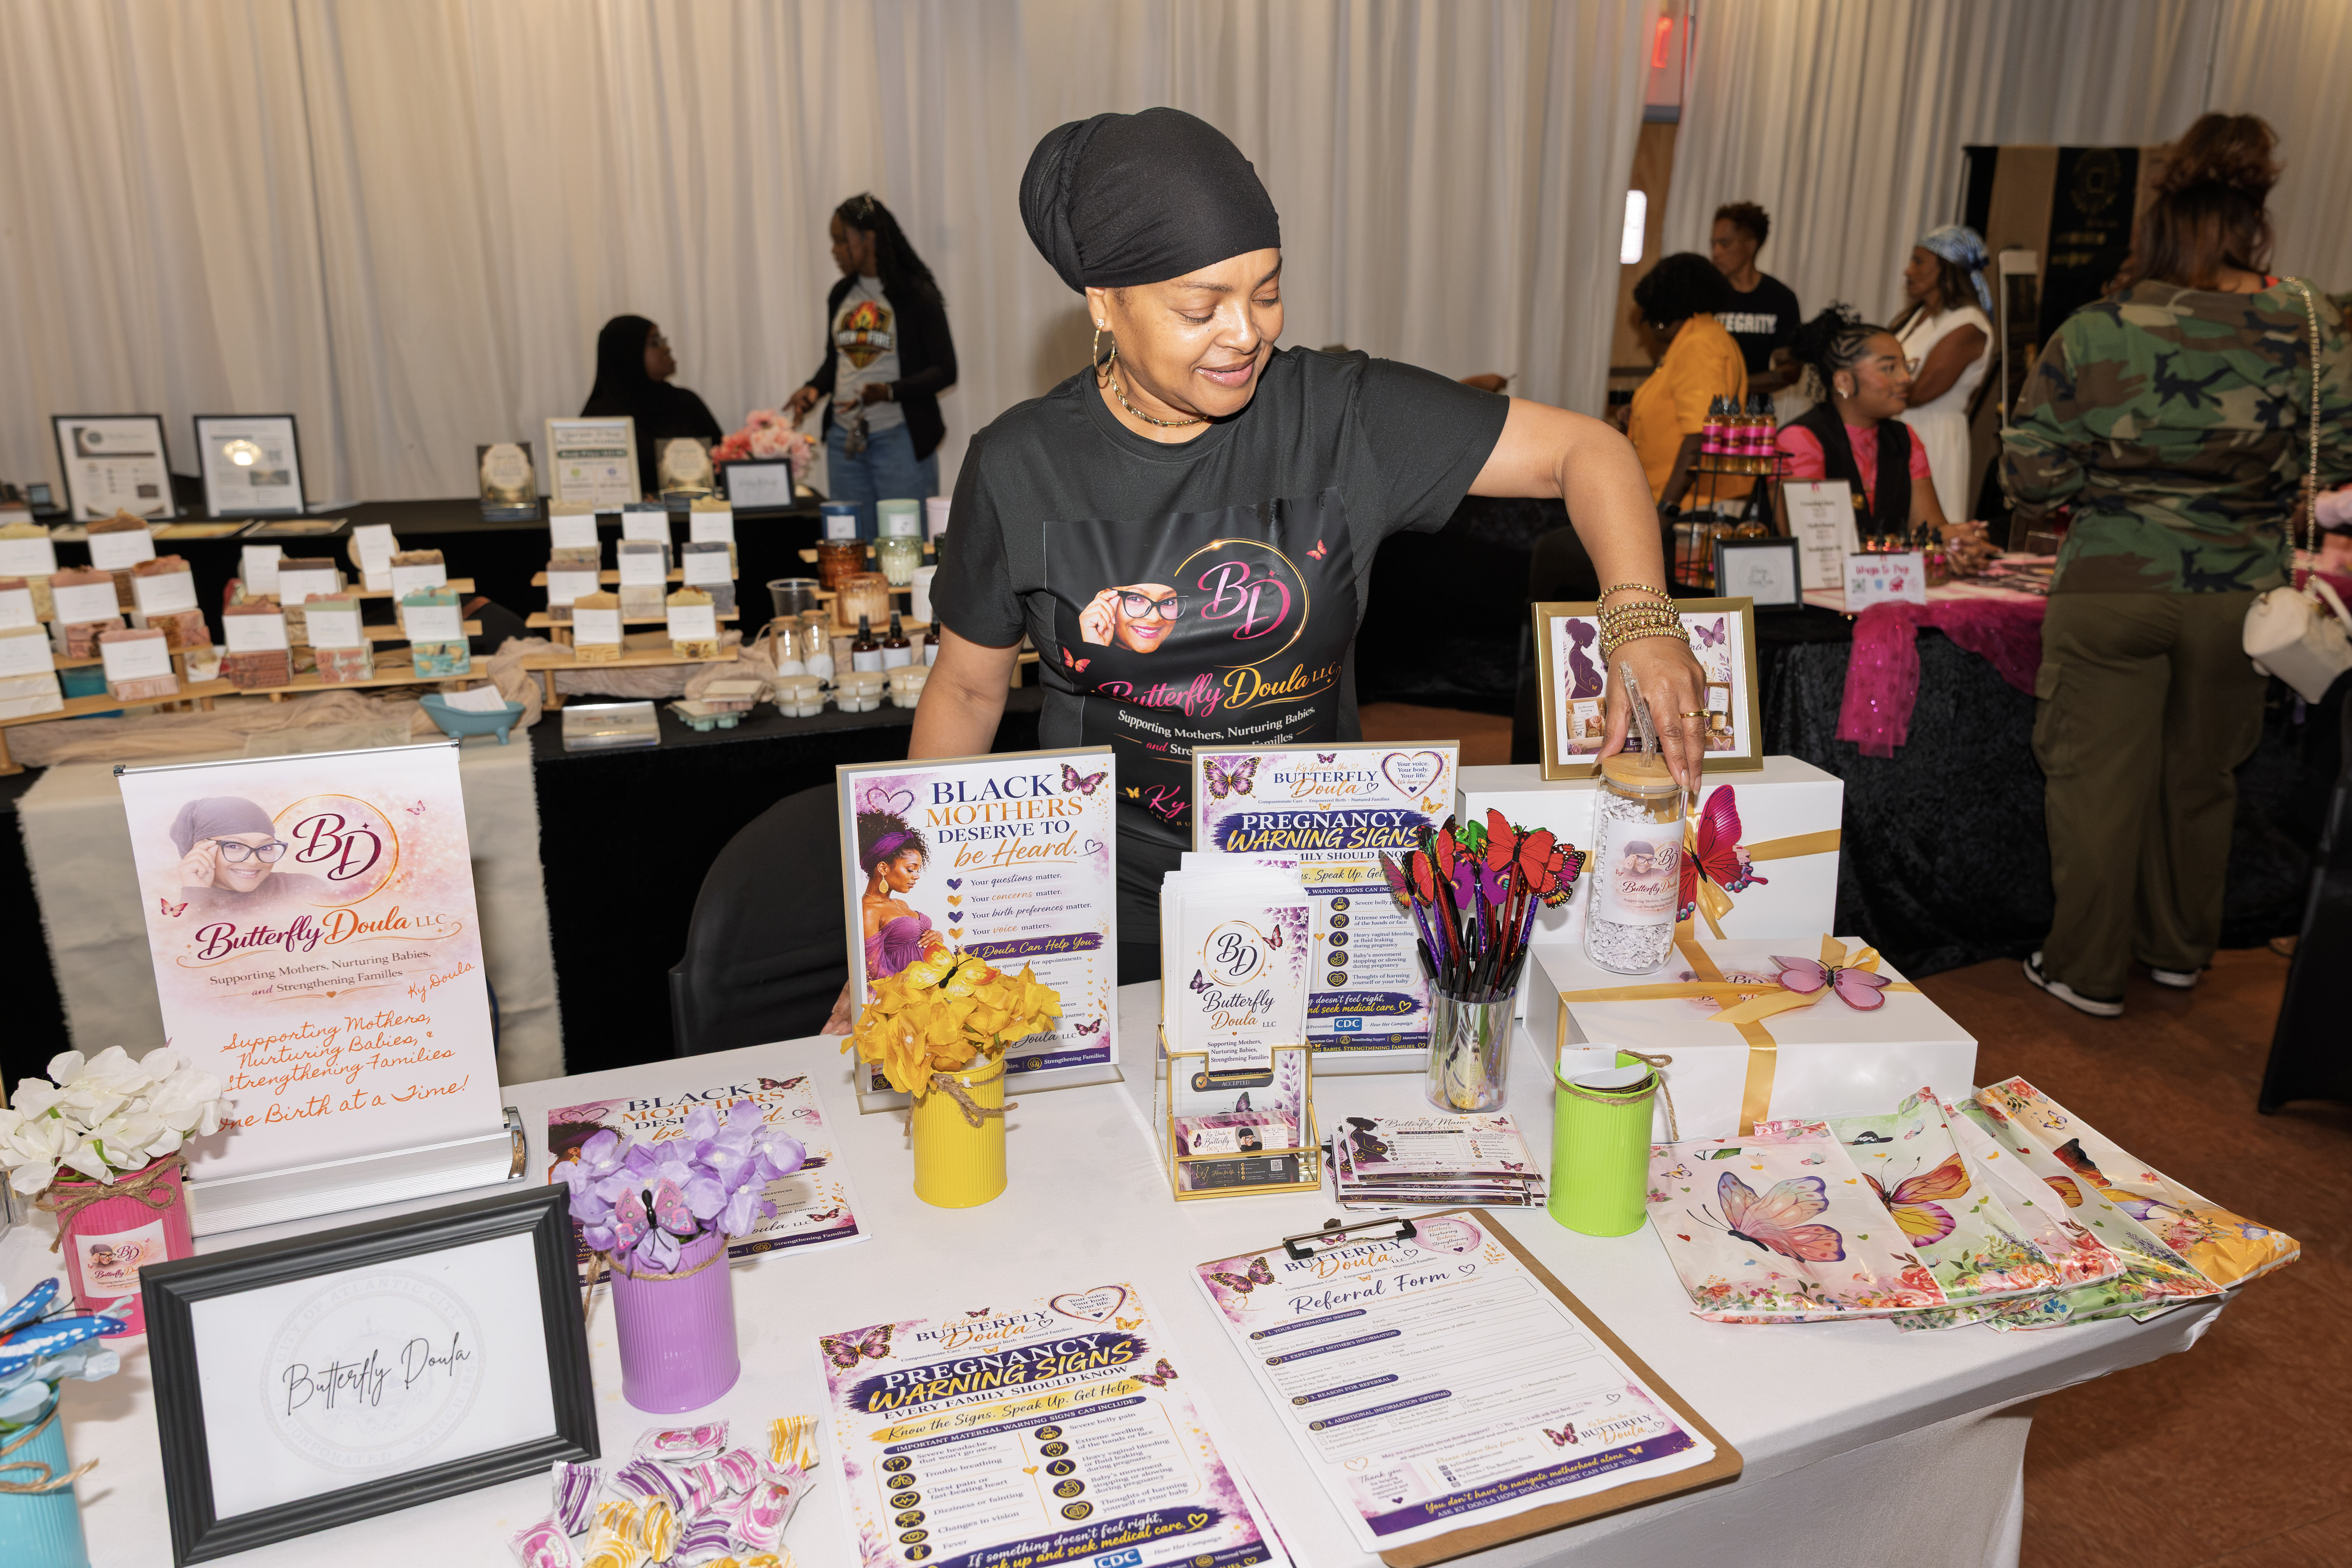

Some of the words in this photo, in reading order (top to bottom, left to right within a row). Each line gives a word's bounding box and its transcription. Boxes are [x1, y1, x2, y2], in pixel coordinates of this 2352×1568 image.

[1198, 561, 1291, 640] BD
[1098, 673, 1225, 718] Butterfly
[1223, 663, 1310, 709] Doula
[1312, 662, 1336, 682] LLC
[1118, 710, 1172, 738] Supporting
[1174, 728, 1225, 740] Mothers,
[1227, 720, 1283, 738] Nurturing
[1146, 740, 1167, 752] and
[931, 774, 1056, 804] BLACK
[1274, 771, 1378, 783] BUTTERFLY
[1290, 779, 1361, 798] Doula
[925, 796, 1083, 828] MOTHERS
[1241, 811, 1406, 830] PREGNANCY
[938, 823, 1034, 843] DESERVE
[1040, 820, 1070, 836] TO
[1227, 828, 1344, 852] WARNING
[1348, 826, 1419, 848] SIGNS
[292, 813, 381, 881] BD
[954, 842, 987, 867] be
[992, 830, 1078, 867] Heard.
[1327, 851, 1374, 860] SHOULD
[1659, 848, 1677, 871] BD
[991, 874, 1034, 887] questions
[1315, 869, 1345, 882] Speak
[1348, 869, 1362, 881] Up.
[1367, 868, 1385, 878] Get
[991, 892, 1034, 901] concerns
[1622, 881, 1661, 895] Butterfly
[991, 906, 1014, 917] birth
[1016, 904, 1065, 918] preferences
[195, 916, 325, 961] Butterfly
[323, 907, 411, 944] Doula
[415, 914, 447, 927] LLC
[993, 925, 1019, 934] voice
[971, 947, 979, 957] A
[982, 944, 1017, 957] Doula
[1020, 942, 1042, 953] Can
[1045, 939, 1070, 952] Help
[1073, 936, 1095, 947] You:
[1216, 933, 1257, 976] BD
[209, 968, 276, 986] Supporting
[278, 960, 330, 976] Mothers,
[332, 954, 390, 972] Nurturing
[392, 949, 432, 962] Babies.
[1042, 956, 1082, 965] appointments
[251, 985, 273, 997] and
[276, 975, 355, 994] Strengthening
[407, 983, 427, 1003] Ky
[429, 963, 475, 987] Doula
[1202, 989, 1275, 1013] Butterfly
[1321, 1004, 1340, 1013] seek
[1342, 1003, 1374, 1012] medical
[1345, 994, 1360, 1004] feel
[1362, 994, 1384, 1005] right,
[220, 1022, 342, 1053] Supporting
[344, 1010, 431, 1032] Mothers,
[1211, 1010, 1258, 1030] Doula
[1336, 1019, 1359, 1028] CDC
[238, 1047, 344, 1069] Nurturing
[1044, 1056, 1082, 1065] Strengthening
[265, 1094, 332, 1125] Birth
[339, 1089, 366, 1110] at
[373, 1095, 387, 1106] a
[627, 1083, 755, 1112] BLACK
[1385, 1119, 1435, 1130] Butterfly
[117, 1245, 139, 1261] BD
[1283, 1240, 1403, 1272] BUTTERFLY
[95, 1270, 125, 1279] Butterfly
[1310, 1252, 1392, 1279] Doula
[1289, 1280, 1386, 1314] Referral
[1394, 1270, 1450, 1291] Form
[916, 1310, 1048, 1342] BUTTERFLY
[939, 1325, 1031, 1350] Doula
[282, 1349, 392, 1416] Butterfly
[401, 1331, 471, 1389] Doula
[882, 1335, 1101, 1390] PREGNANCY
[868, 1365, 1025, 1412] WARNING
[1034, 1341, 1136, 1379] SIGNS
[884, 1403, 940, 1421] EVERY
[945, 1390, 1005, 1407] FAMILY
[1011, 1376, 1076, 1395] SHOULD
[1078, 1365, 1127, 1381] KNOW
[887, 1425, 926, 1441] Know
[929, 1417, 950, 1430] the
[955, 1412, 995, 1427] Signs.
[1002, 1401, 1044, 1417] Speak
[1047, 1396, 1069, 1410] Up.
[1074, 1389, 1097, 1402] Get
[1101, 1382, 1134, 1397] Help.
